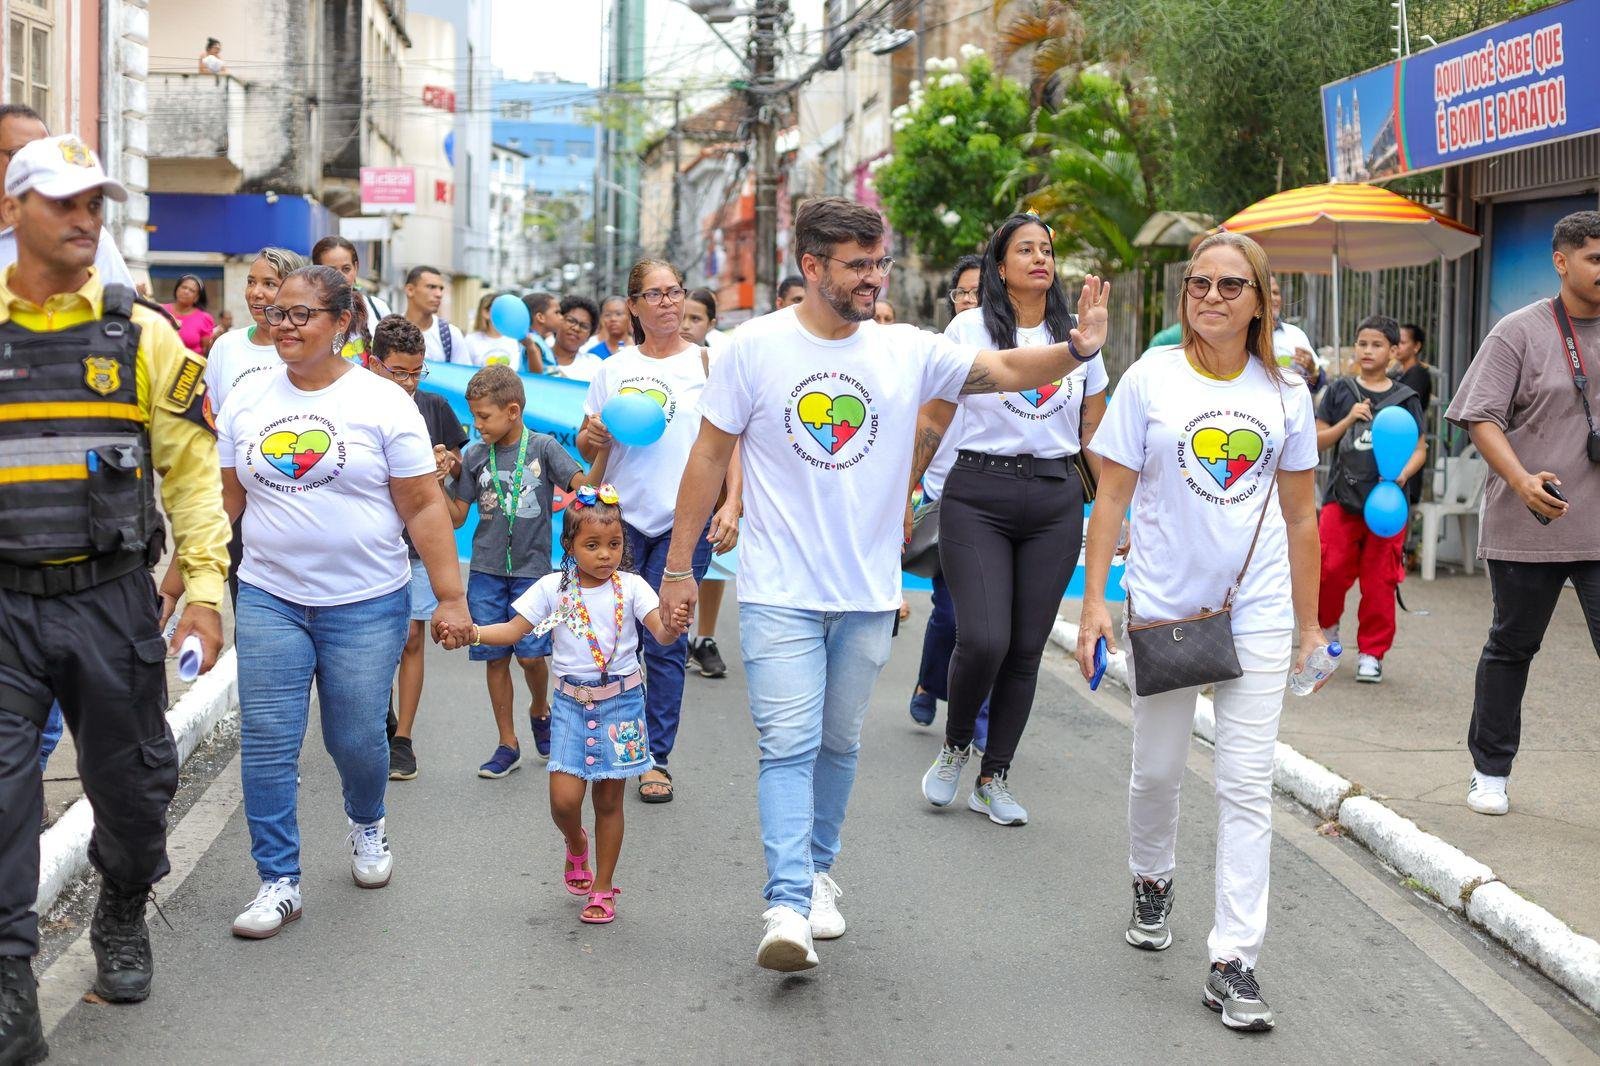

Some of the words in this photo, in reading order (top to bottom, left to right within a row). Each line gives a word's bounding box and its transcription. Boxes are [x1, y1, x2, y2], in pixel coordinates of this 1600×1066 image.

[1435, 59, 1462, 100] AQUI
[1463, 42, 1495, 90] VOCÊ
[1498, 36, 1532, 80] SABE
[1534, 25, 1563, 72] QUE
[1437, 103, 1447, 152] É
[1449, 102, 1482, 149] BOM
[1484, 97, 1495, 140] E
[1497, 78, 1565, 137] BARATO!
[1570, 350, 1580, 368] EOS
[172, 361, 200, 401] SUTRAM
[232, 366, 261, 388] CONHEÇA
[790, 371, 829, 398] CONHEÇA
[839, 373, 872, 404] ENTENDA
[665, 400, 677, 424] AJUDE
[784, 407, 793, 434] APOIE
[1003, 400, 1036, 420] RESPEITE
[1040, 404, 1064, 420] INCLUA
[1184, 410, 1223, 432] CONHEÇA
[1233, 410, 1270, 438] ENTENDA
[259, 414, 300, 437] CONHEÇA
[309, 414, 338, 437] ENTENDA
[867, 413, 879, 446] AJUDE
[245, 442, 256, 466] APOIE
[336, 441, 346, 469] AJUDE
[792, 442, 831, 470] RESPEITE
[836, 452, 865, 470] INCLUA
[1177, 440, 1187, 469] APOIE
[1256, 447, 1273, 477] AJUDE
[253, 472, 297, 493] RESPEITE
[302, 475, 335, 492] INCLUA
[1185, 477, 1226, 505] RESPEITE
[1230, 484, 1258, 505] INCLUA
[1172, 627, 1183, 641] C
